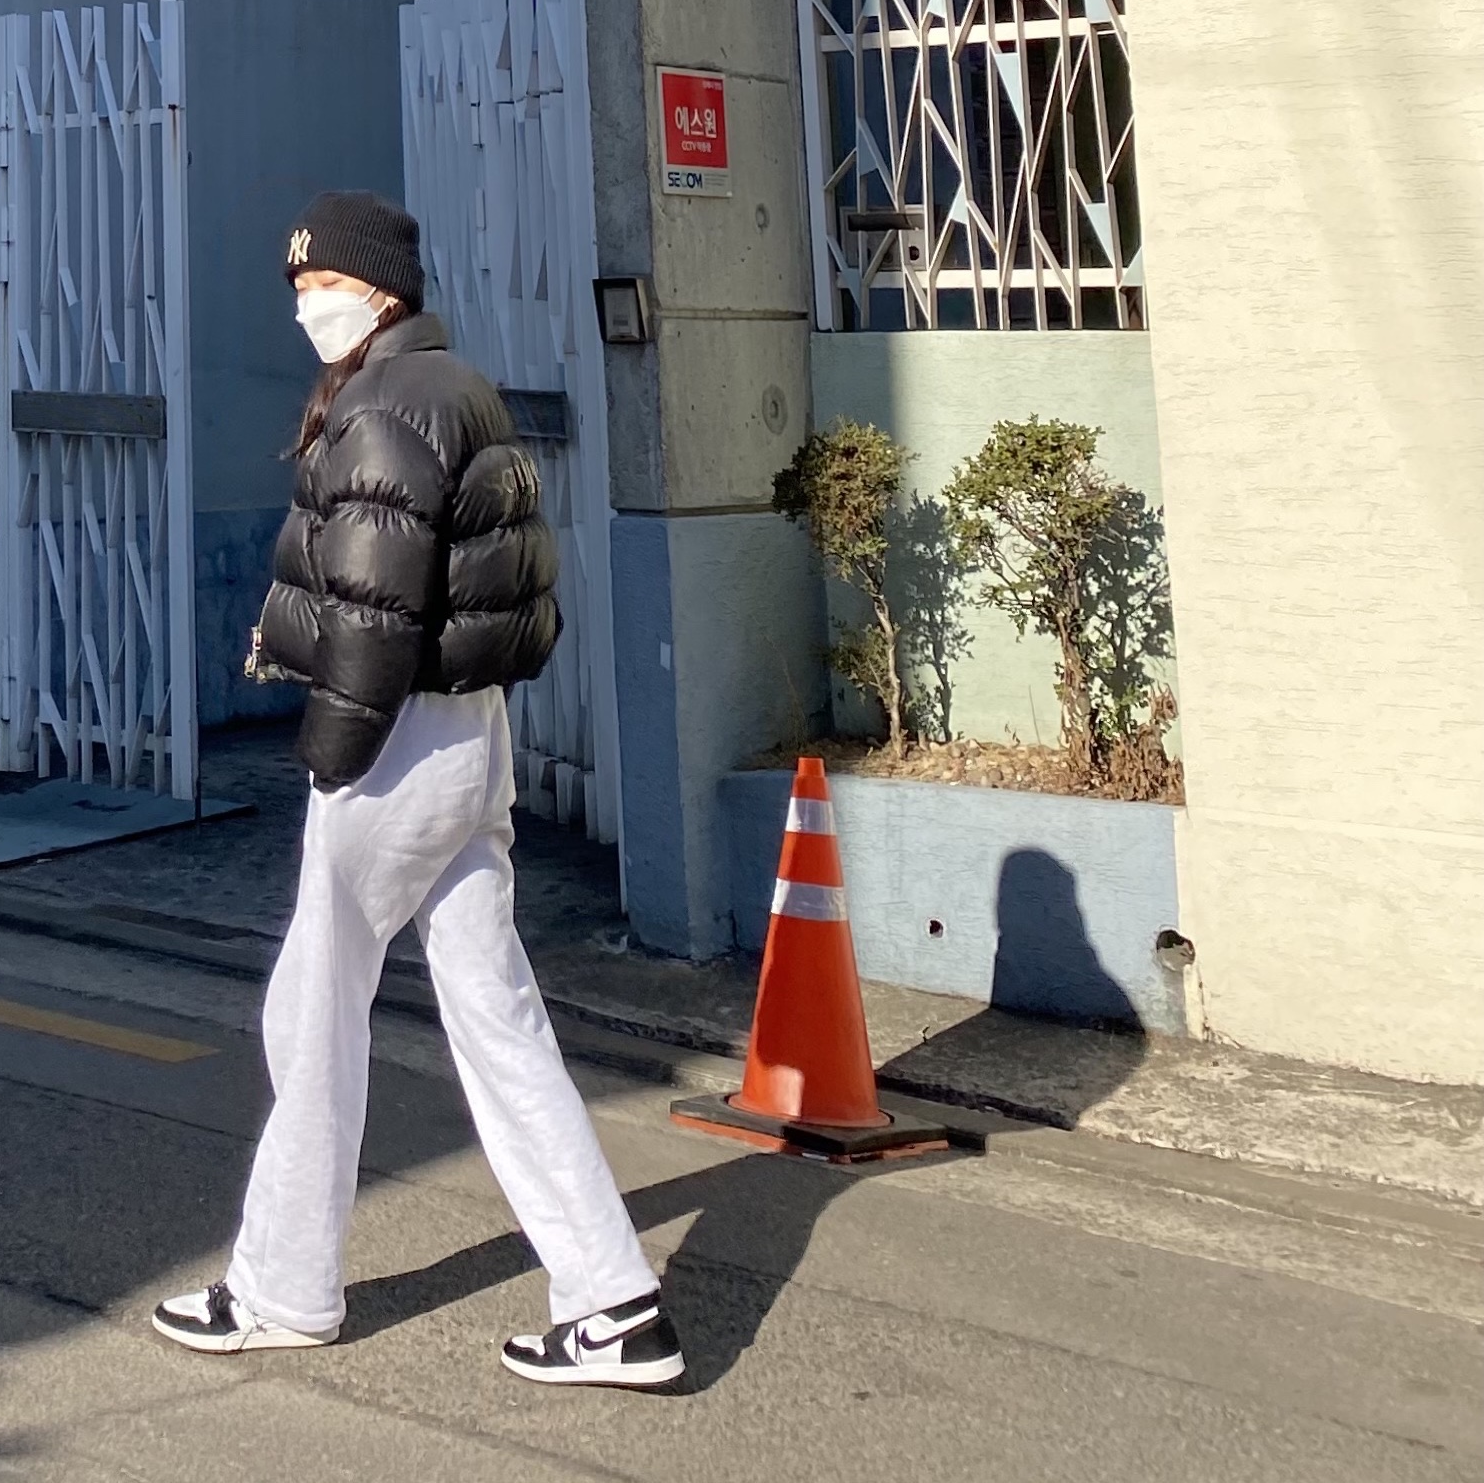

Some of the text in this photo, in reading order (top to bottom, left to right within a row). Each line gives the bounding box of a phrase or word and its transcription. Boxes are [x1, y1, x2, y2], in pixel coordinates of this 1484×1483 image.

[675, 106, 717, 139] 에스원
[667, 172, 703, 189] SECOM
[287, 228, 312, 265] NY
